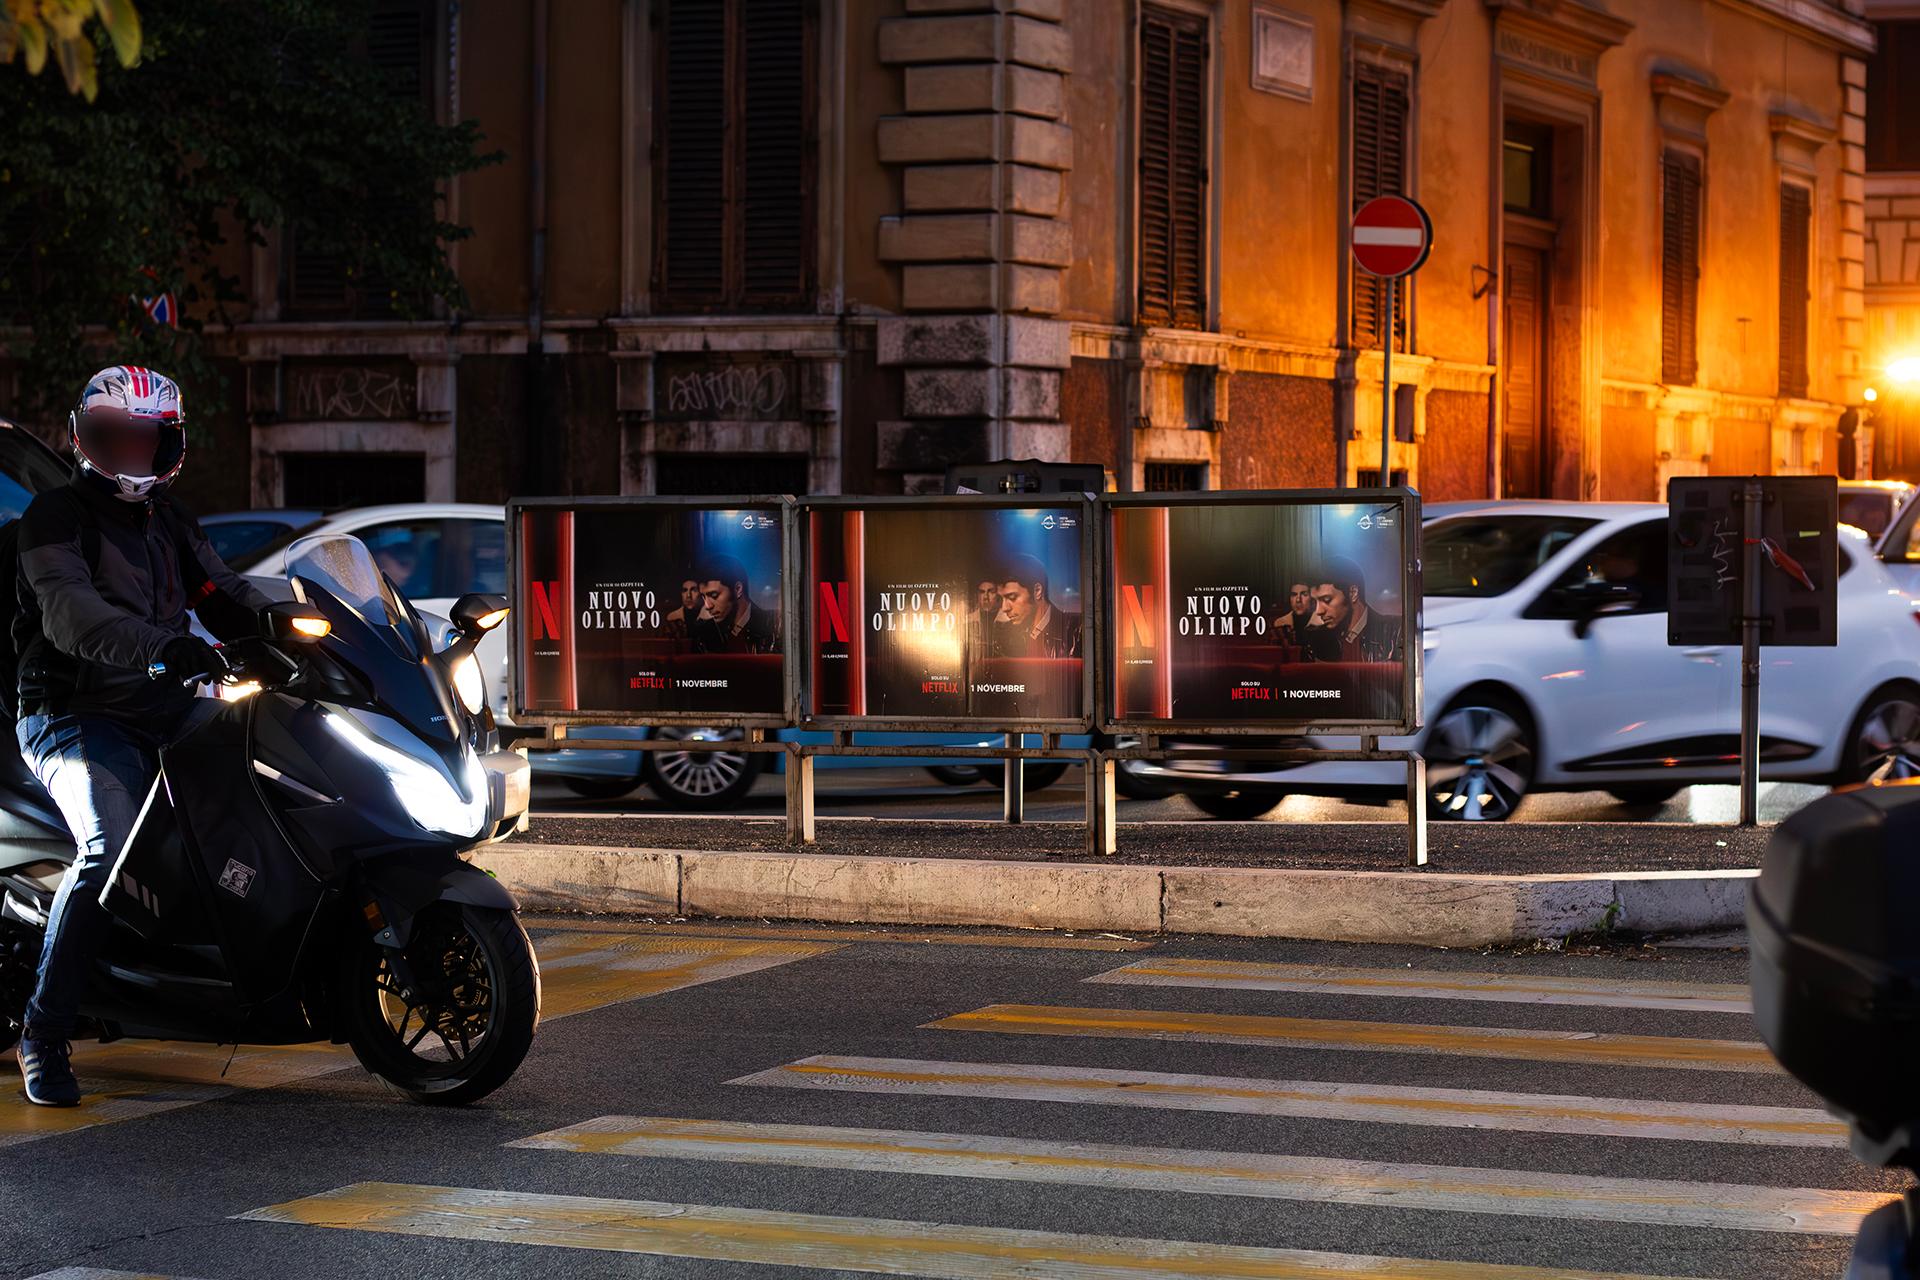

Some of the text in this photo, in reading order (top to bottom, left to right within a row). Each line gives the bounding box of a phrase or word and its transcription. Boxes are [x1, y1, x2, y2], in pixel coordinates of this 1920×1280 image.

[589, 591, 656, 610] NUOVO
[880, 592, 951, 611] NUOVO
[1187, 595, 1262, 615] NUOVO
[531, 581, 561, 641] N
[582, 610, 661, 630] OLIMPO
[818, 582, 849, 643] N
[1122, 584, 1155, 648] N
[872, 612, 956, 632] OLIMPO
[1179, 616, 1267, 636] OLIMPO
[630, 677, 728, 689] NETFLIX 1 NOVEMBRE
[922, 682, 1025, 694] NETFLIX 1 NOVEMBRE
[1231, 687, 1341, 700] NETFLIX 1 NOVEMBRE
